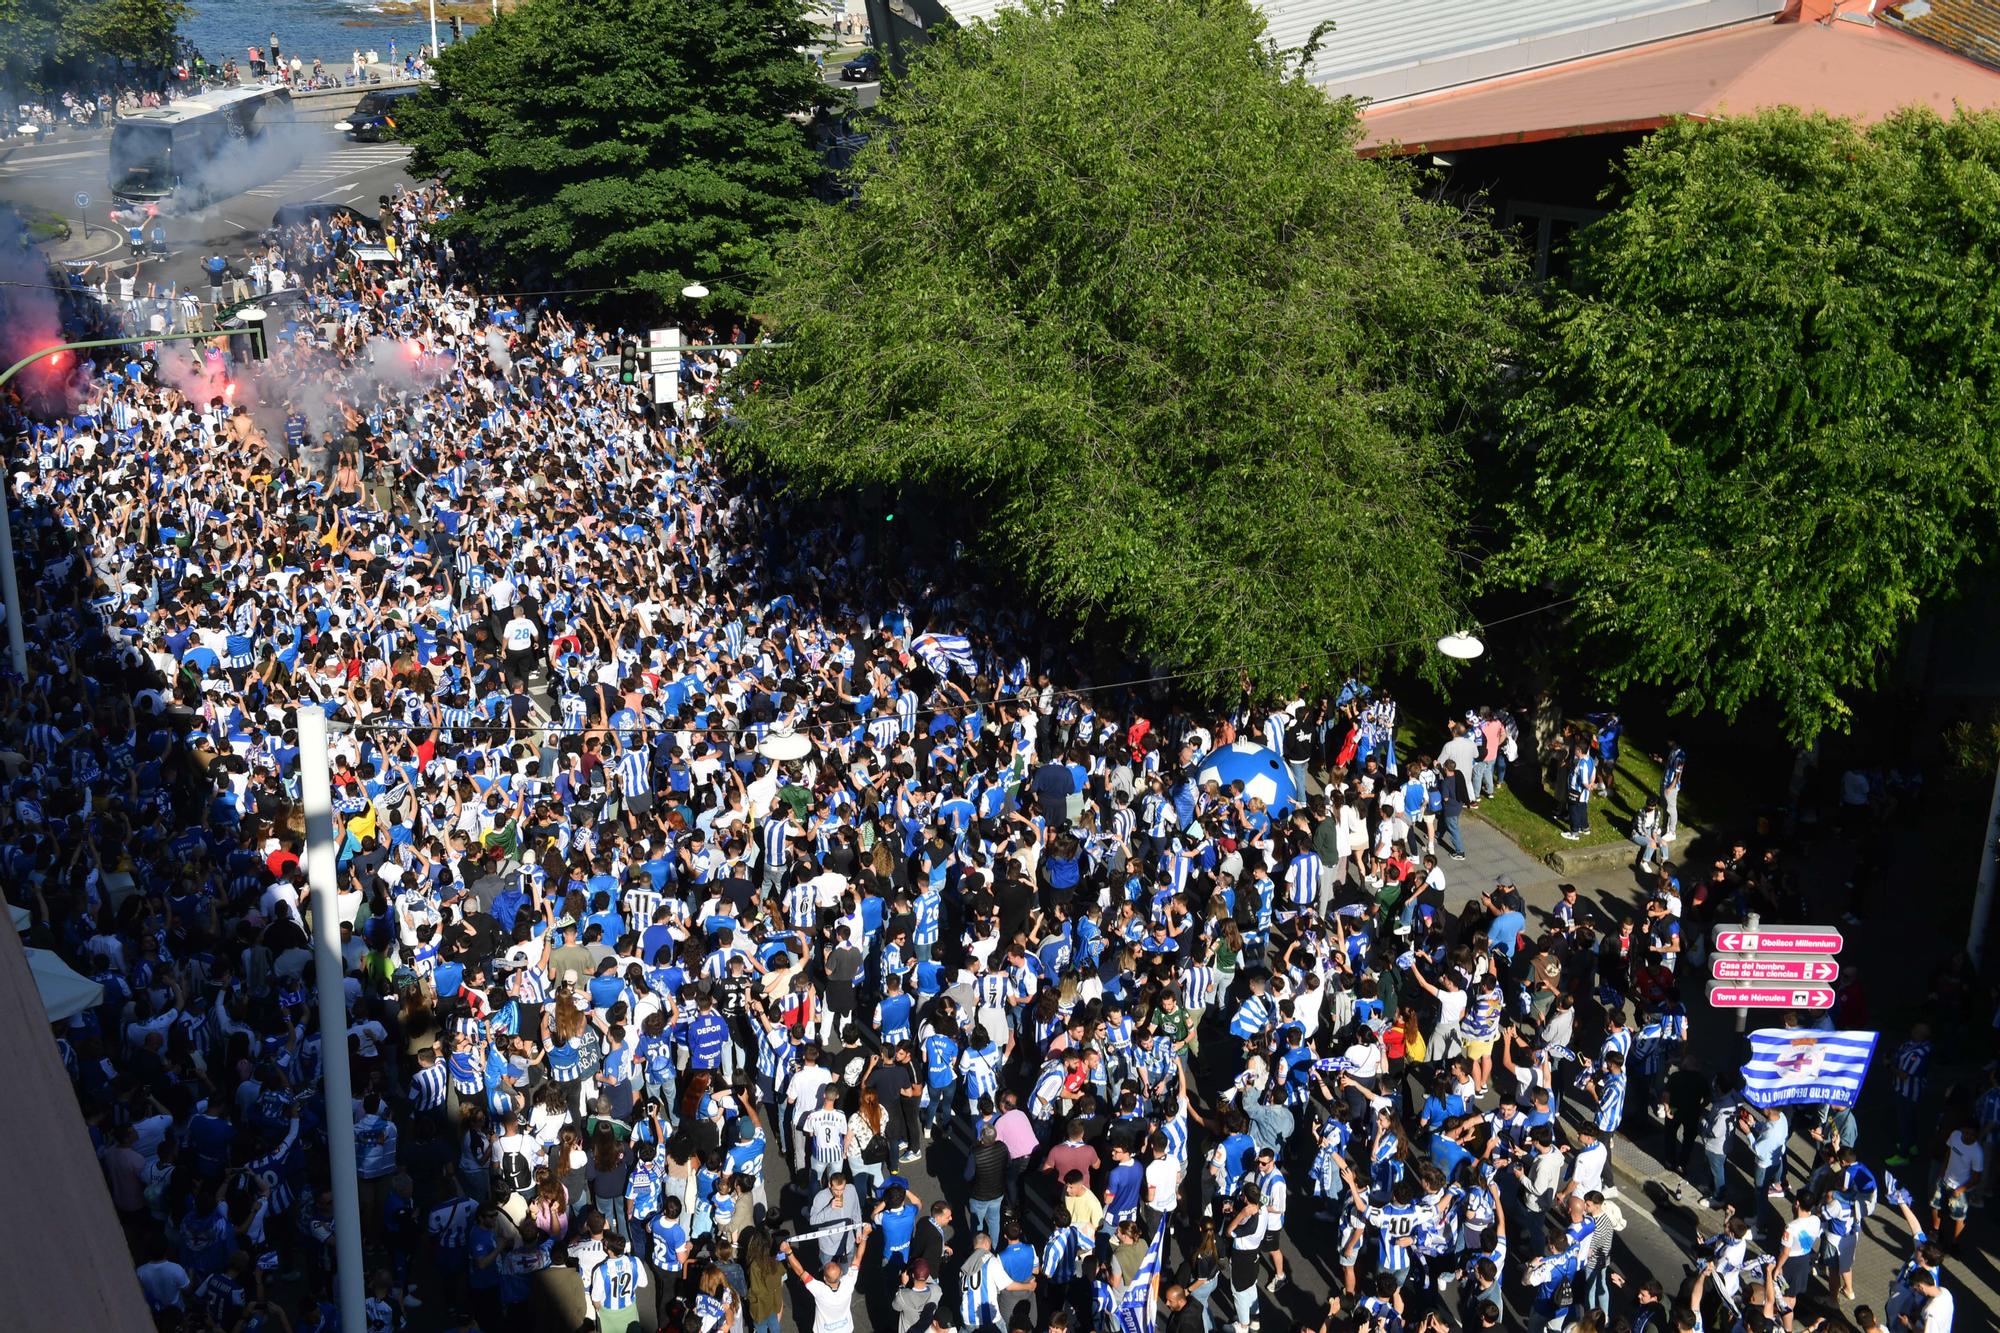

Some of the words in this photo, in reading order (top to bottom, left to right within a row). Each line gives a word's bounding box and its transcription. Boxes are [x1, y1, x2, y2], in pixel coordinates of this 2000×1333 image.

[472, 574, 481, 588] 8
[99, 603, 114, 615] 10
[514, 628, 530, 640] 28
[634, 894, 648, 913] 11
[800, 897, 810, 914] 6
[926, 903, 939, 924] 26
[1761, 939, 1794, 947] Obelisco
[1795, 940, 1836, 948] Millennium
[1720, 962, 1740, 970] Casa
[1741, 962, 1754, 970] del
[1755, 962, 1785, 970] hombre
[1719, 969, 1739, 977] Casa
[1741, 969, 1751, 977] de
[1766, 970, 1798, 978] ciencias
[1716, 993, 1736, 1001] Torre
[1738, 993, 1749, 1001] de
[1751, 993, 1786, 1002] Hércules
[696, 1025, 721, 1035] DEPOR
[1389, 1217, 1410, 1235] 10
[611, 1272, 632, 1298] 12
